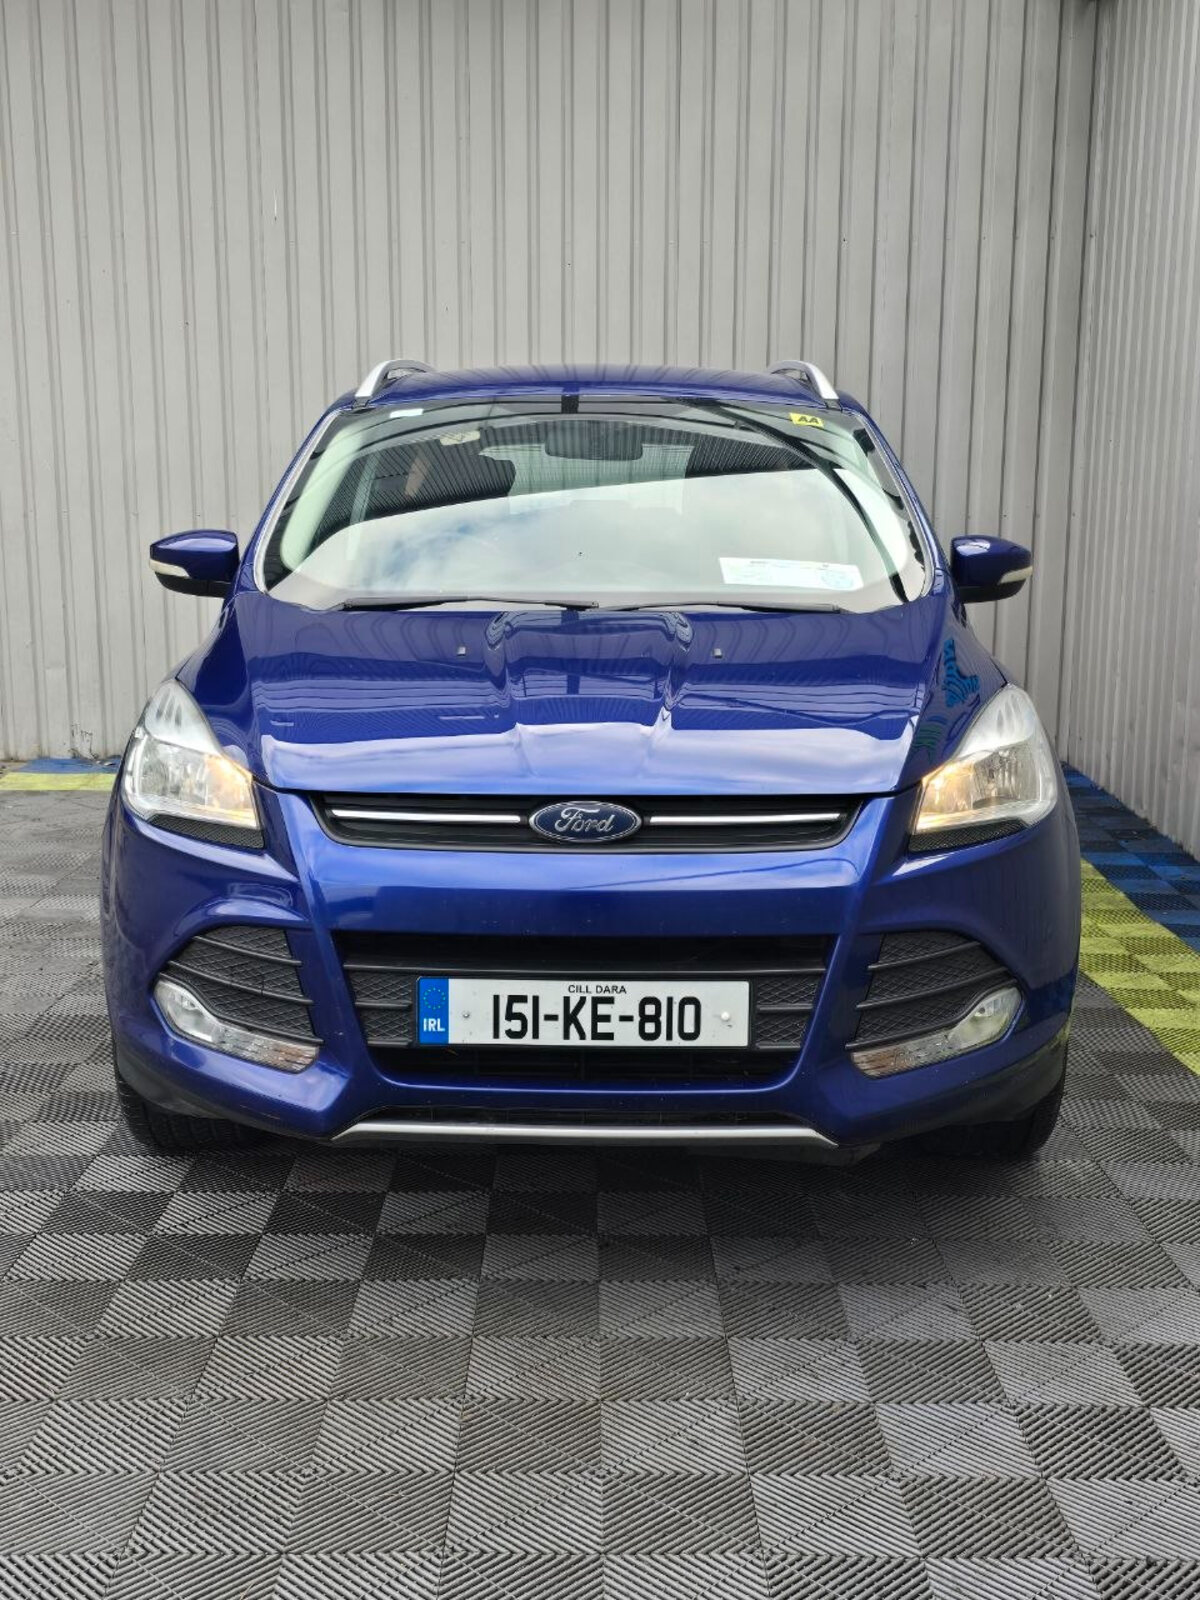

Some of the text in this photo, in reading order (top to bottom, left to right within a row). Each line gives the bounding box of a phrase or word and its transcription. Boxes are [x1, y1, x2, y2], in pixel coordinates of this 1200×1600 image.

[798, 416, 819, 424] AA
[554, 807, 615, 832] Ford
[568, 985, 627, 995] CILL DARA
[423, 1018, 446, 1032] IRL
[493, 995, 702, 1041] 151-KE-810
